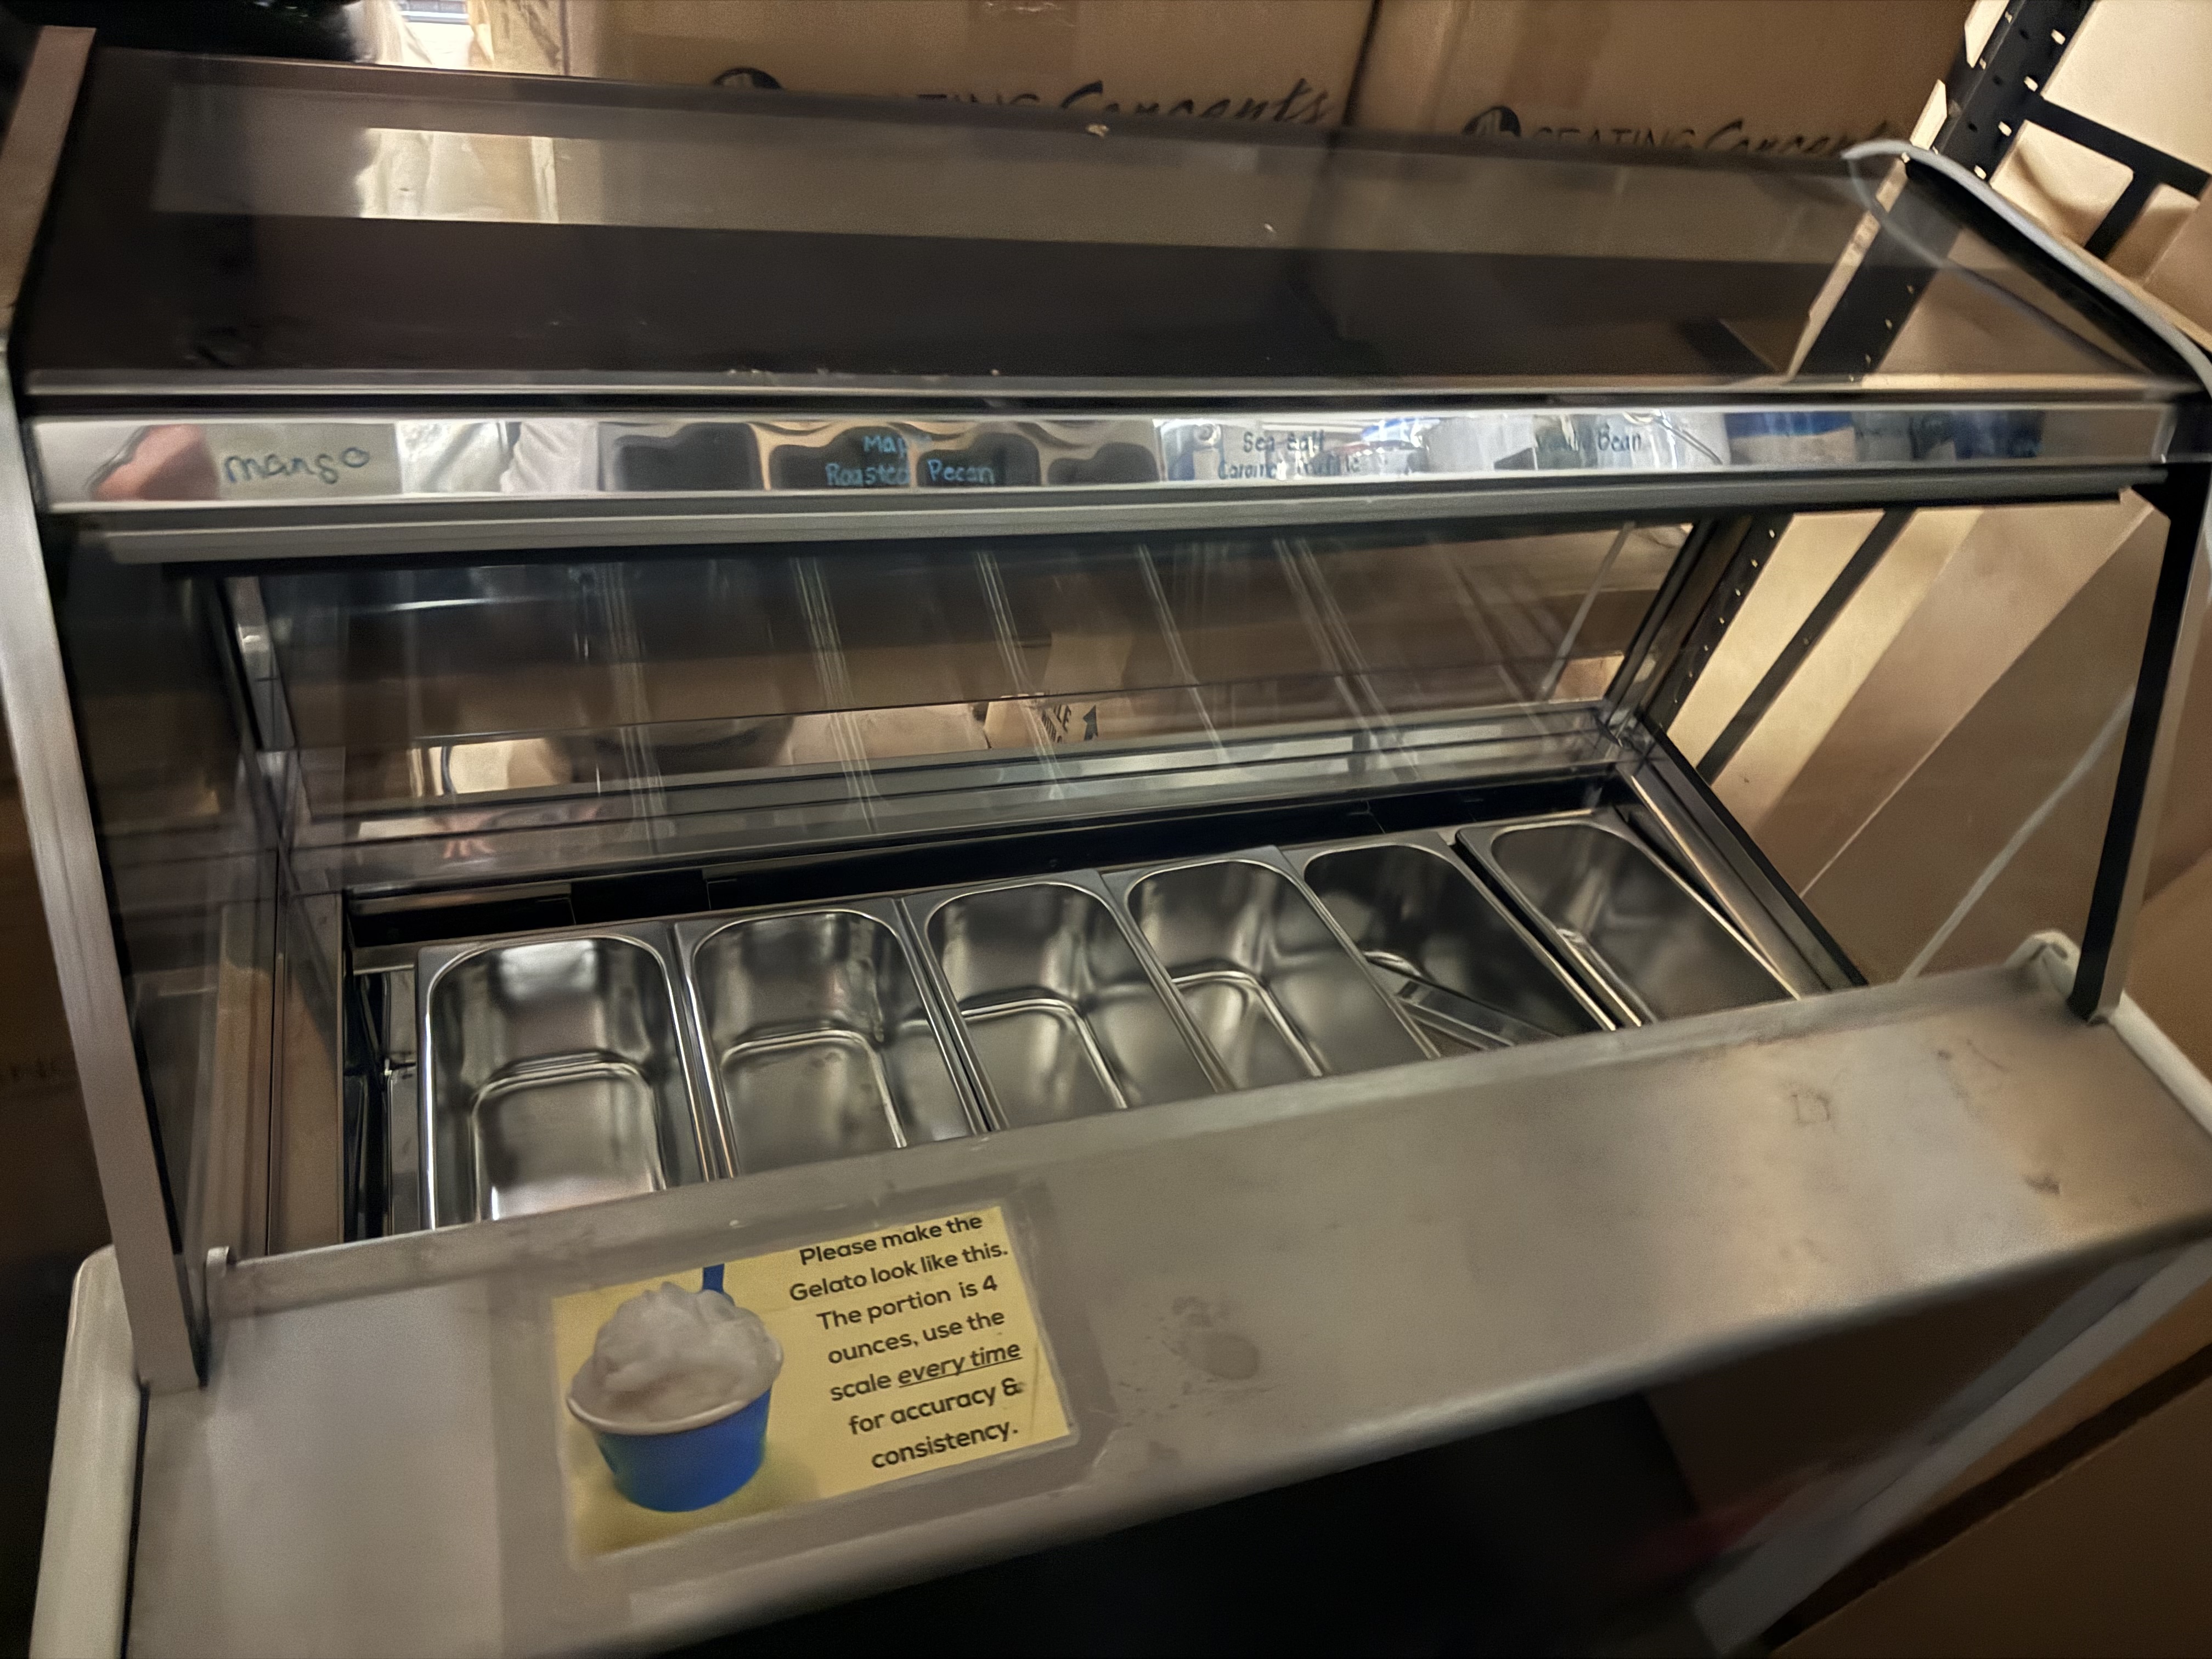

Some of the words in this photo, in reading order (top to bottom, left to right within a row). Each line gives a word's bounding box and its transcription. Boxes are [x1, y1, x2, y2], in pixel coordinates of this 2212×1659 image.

[225, 447, 370, 484] mango
[927, 459, 996, 484] Pecan
[799, 1239, 877, 1266] Please
[881, 1224, 943, 1249] make
[945, 1216, 983, 1234] the
[789, 1274, 867, 1301] Gelato
[870, 1260, 918, 1284] look
[920, 1254, 958, 1273] like
[961, 1242, 1008, 1263] this.
[816, 1310, 862, 1330] The
[867, 1290, 951, 1324] portion
[958, 1282, 979, 1299] is
[982, 1274, 998, 1291] 4
[828, 1333, 919, 1364] ounces,
[922, 1322, 963, 1342] use
[966, 1311, 1005, 1331] the
[830, 1373, 892, 1402] scale
[897, 1355, 965, 1386] every
[970, 1343, 1022, 1367] time
[848, 1414, 885, 1435] for
[890, 1386, 996, 1425] accuracy
[1001, 1377, 1020, 1396] &
[871, 1421, 1018, 1469] consistency.
